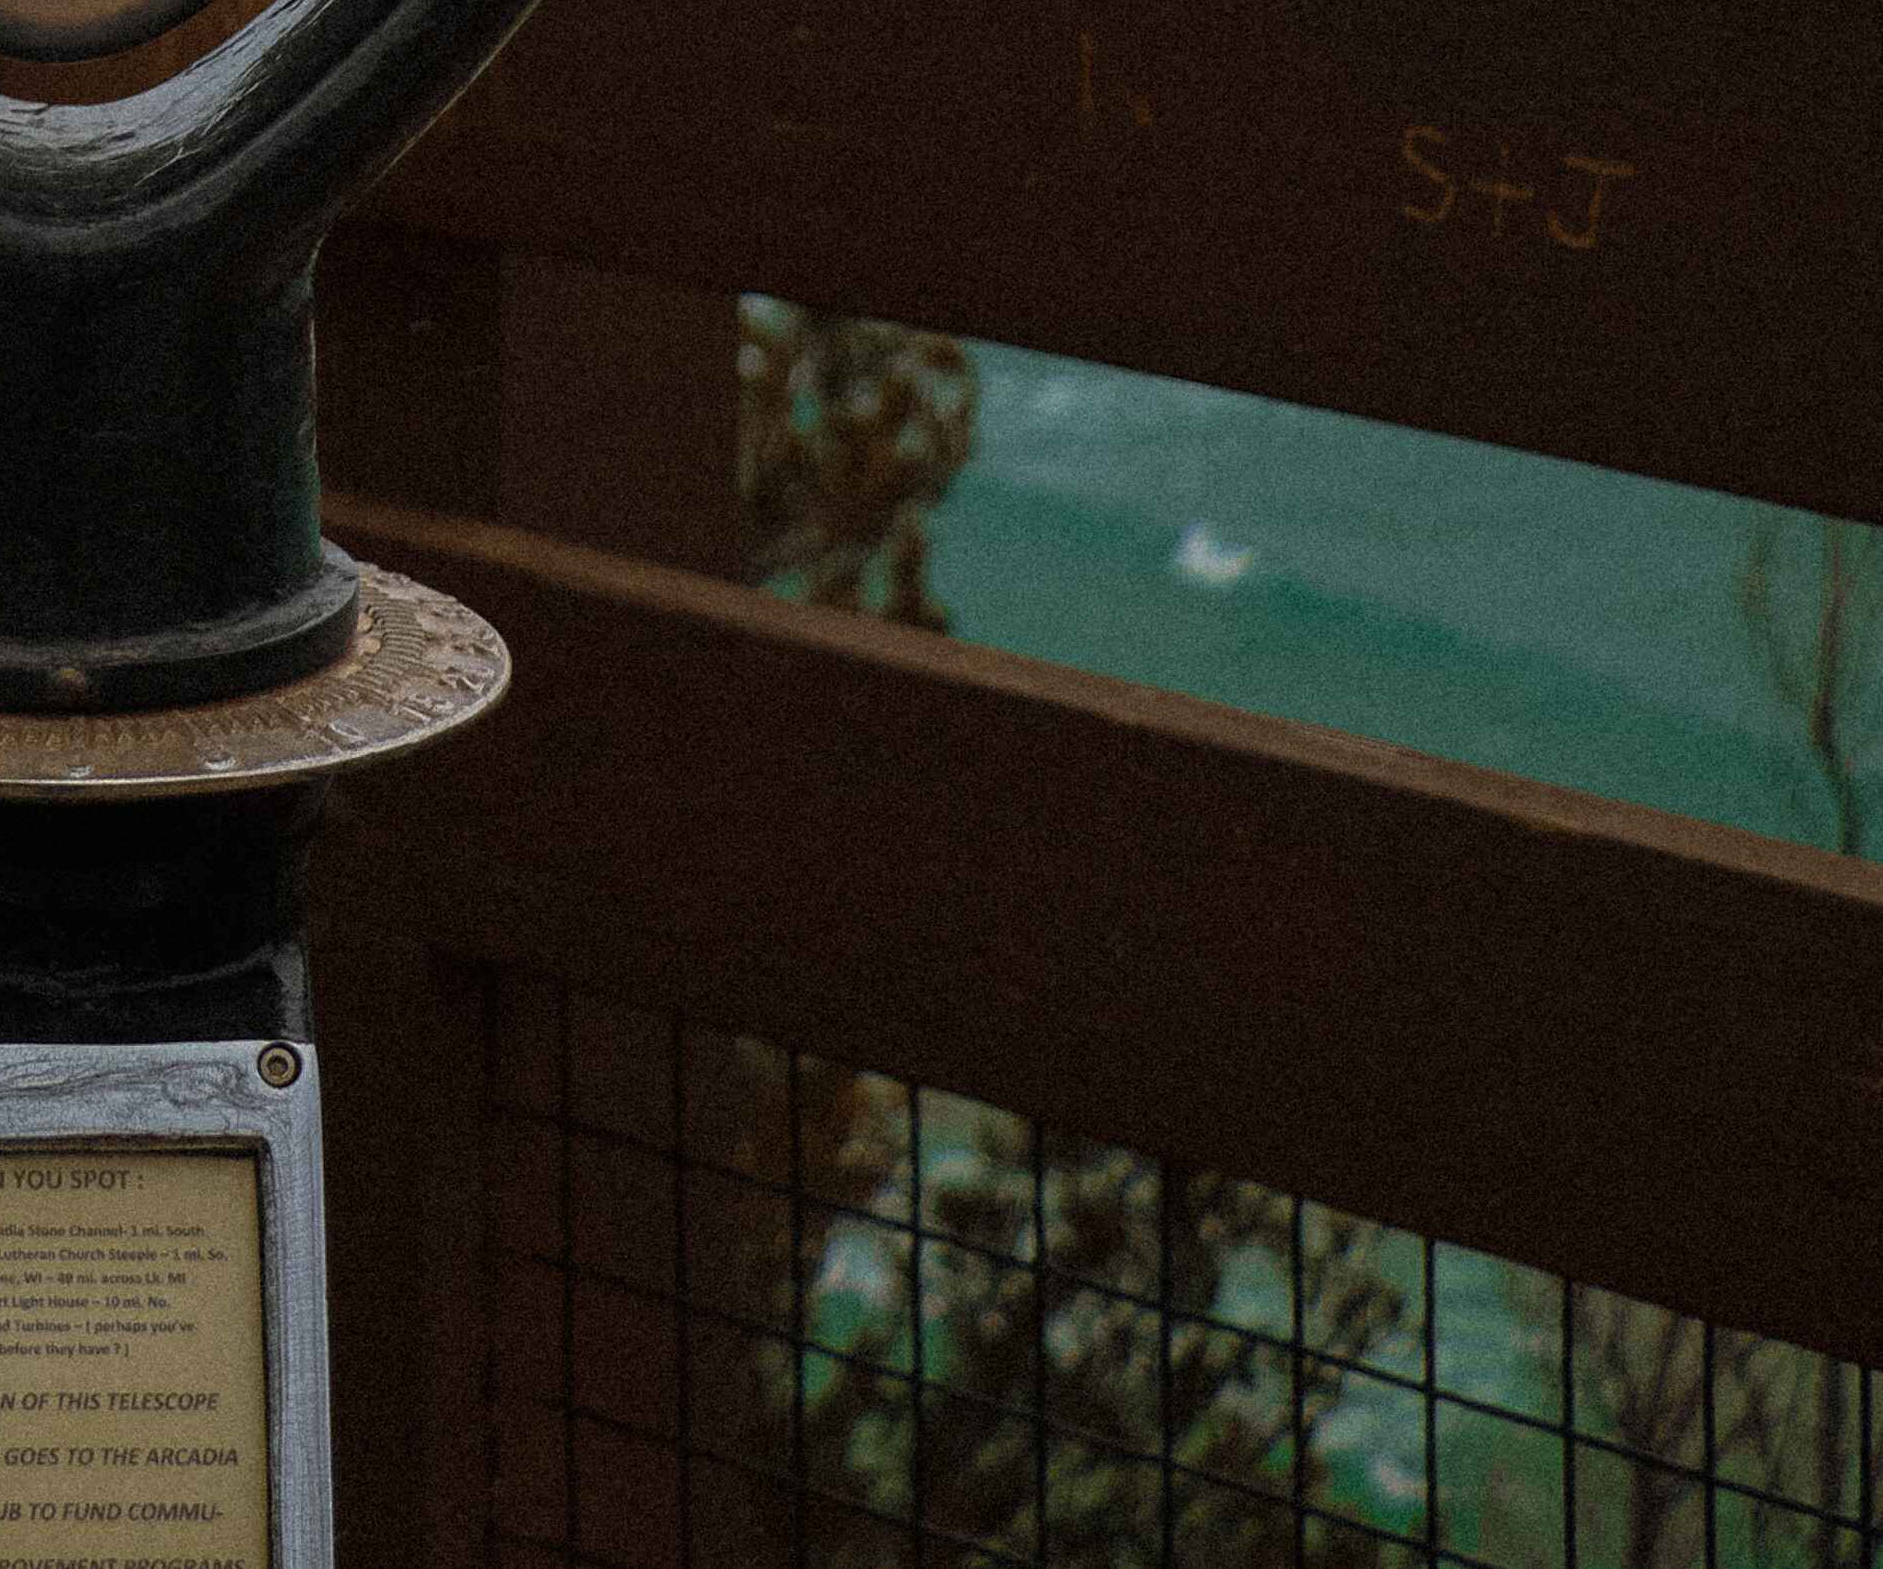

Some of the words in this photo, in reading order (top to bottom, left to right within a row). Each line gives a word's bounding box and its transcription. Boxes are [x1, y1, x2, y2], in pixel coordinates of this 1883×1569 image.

[15, 1169, 62, 1190] YOU
[70, 1169, 131, 1190] SPOT
[28, 1224, 66, 1238] Stone
[167, 1225, 205, 1239] South
[59, 1248, 105, 1261] Church
[108, 1248, 157, 1262] Steeple
[101, 1273, 142, 1285] across
[167, 1272, 187, 1284] MI
[13, 1296, 45, 1310] Light
[48, 1296, 89, 1309] House
[15, 1319, 72, 1333] Turbines
[94, 1320, 148, 1335] perhaps
[45, 1342, 75, 1358] they
[78, 1343, 110, 1356] have
[21, 1392, 50, 1411] OF
[56, 1392, 101, 1411] THIS
[107, 1392, 219, 1411] TELESCOPE
[4, 1447, 60, 1466] GOES
[67, 1447, 95, 1467] TO
[101, 1447, 141, 1466] THE
[145, 1446, 240, 1466] ARCADIA
[28, 1503, 57, 1522] TO
[63, 1503, 120, 1522] FUND
[127, 1503, 224, 1522] COMMU-
